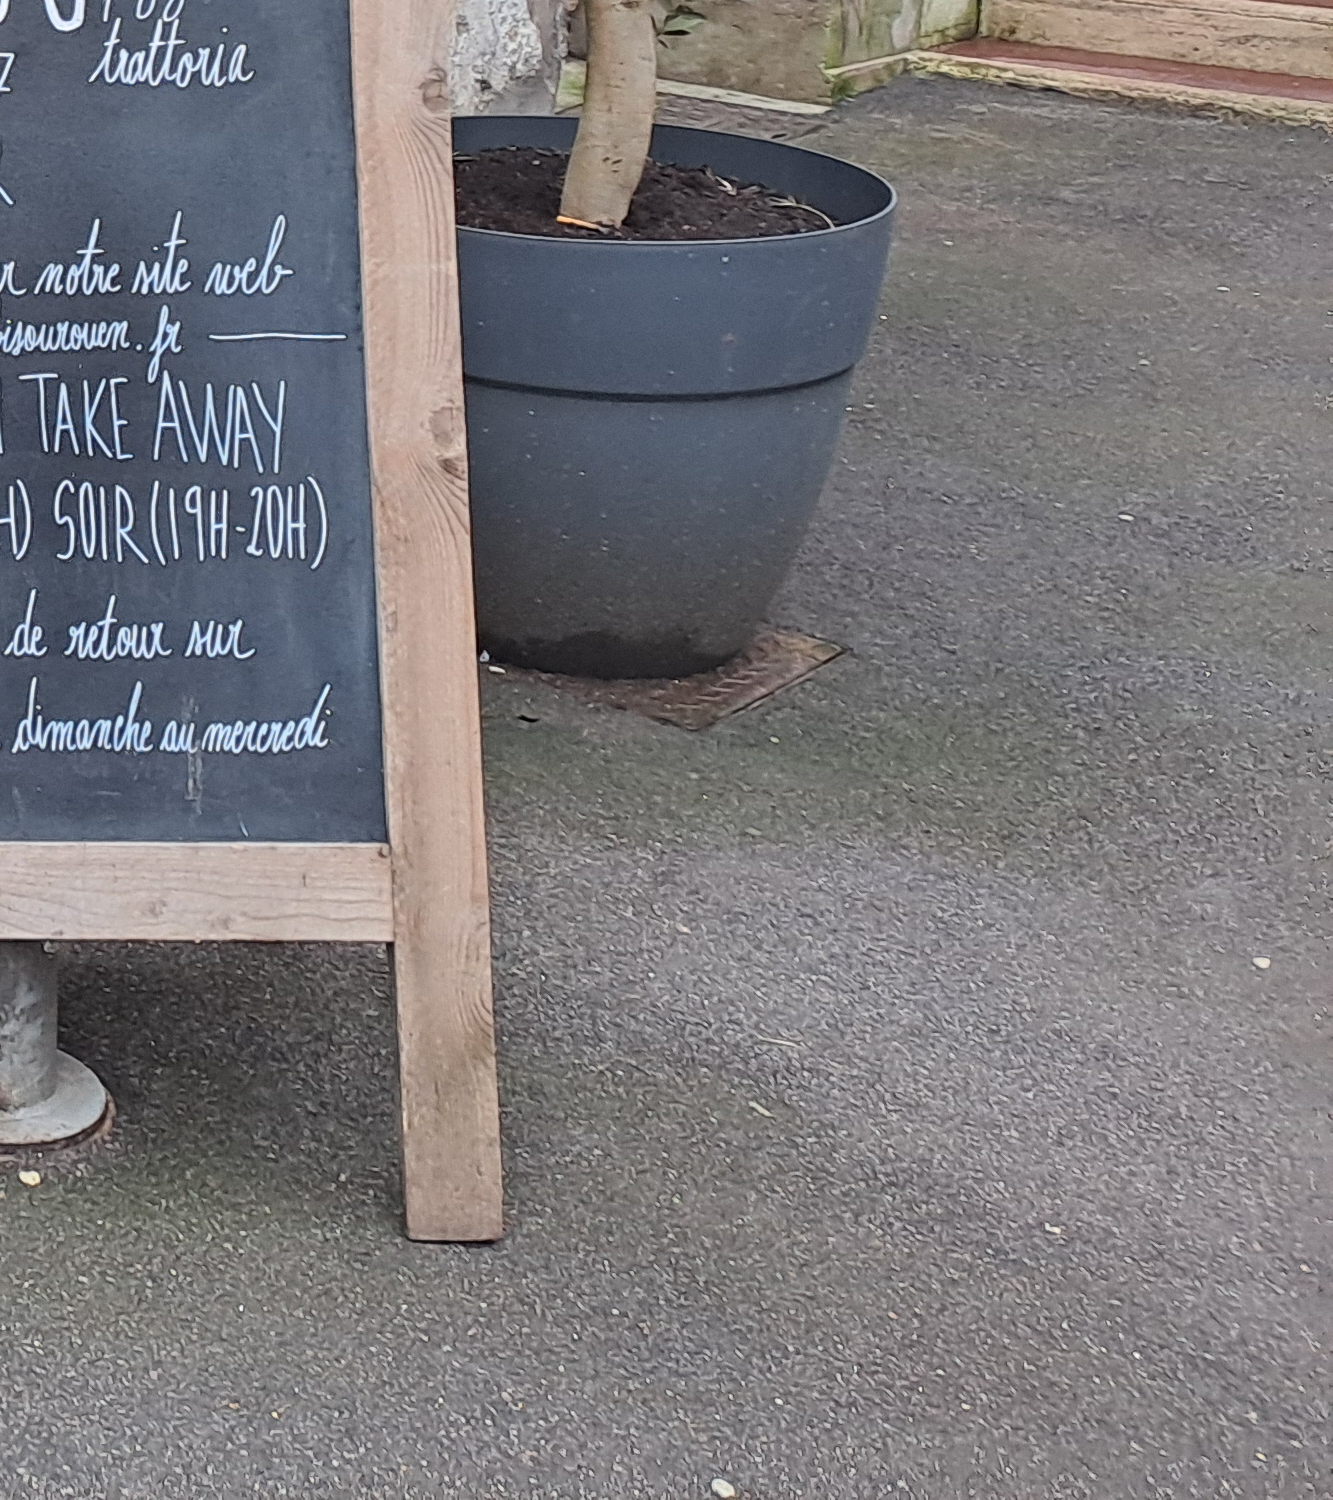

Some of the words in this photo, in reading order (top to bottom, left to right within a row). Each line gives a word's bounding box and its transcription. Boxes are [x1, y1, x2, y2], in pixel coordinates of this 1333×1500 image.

[88, 16, 255, 89] trattoria
[33, 218, 123, 297] notre
[130, 210, 193, 296] site
[204, 214, 295, 296] web
[18, 371, 134, 461] TAKE
[153, 369, 286, 475] AWAY
[3, 587, 49, 658] de
[63, 593, 174, 662] retour
[184, 617, 256, 660] sur
[11, 675, 155, 755] dimanche
[159, 719, 199, 755] au
[201, 682, 332, 755] mercredi
